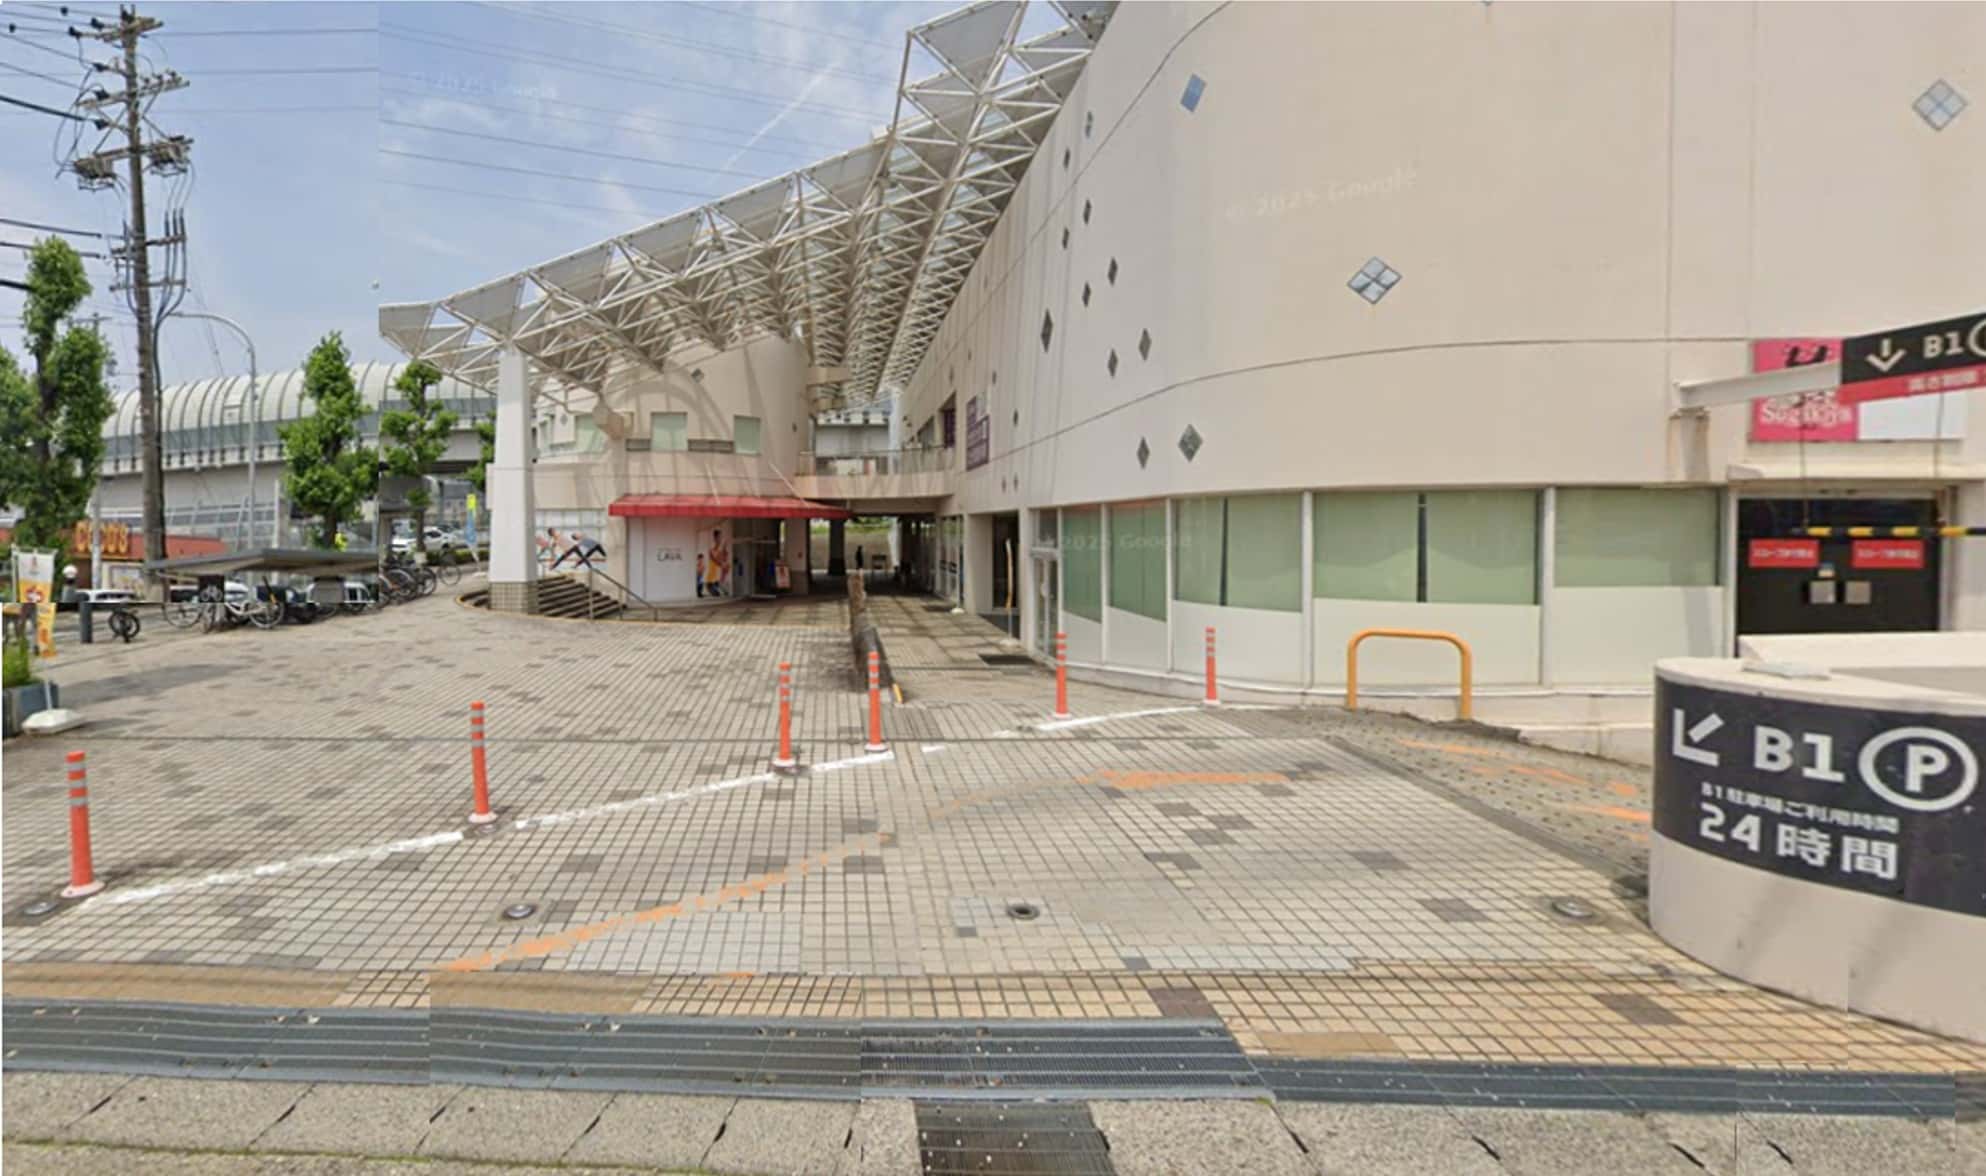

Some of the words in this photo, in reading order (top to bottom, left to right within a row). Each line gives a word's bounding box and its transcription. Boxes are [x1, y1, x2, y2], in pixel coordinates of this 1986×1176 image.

[1922, 330, 1965, 360] B1
[1753, 724, 1846, 783] B1
[1699, 802, 1898, 881] 24時間
